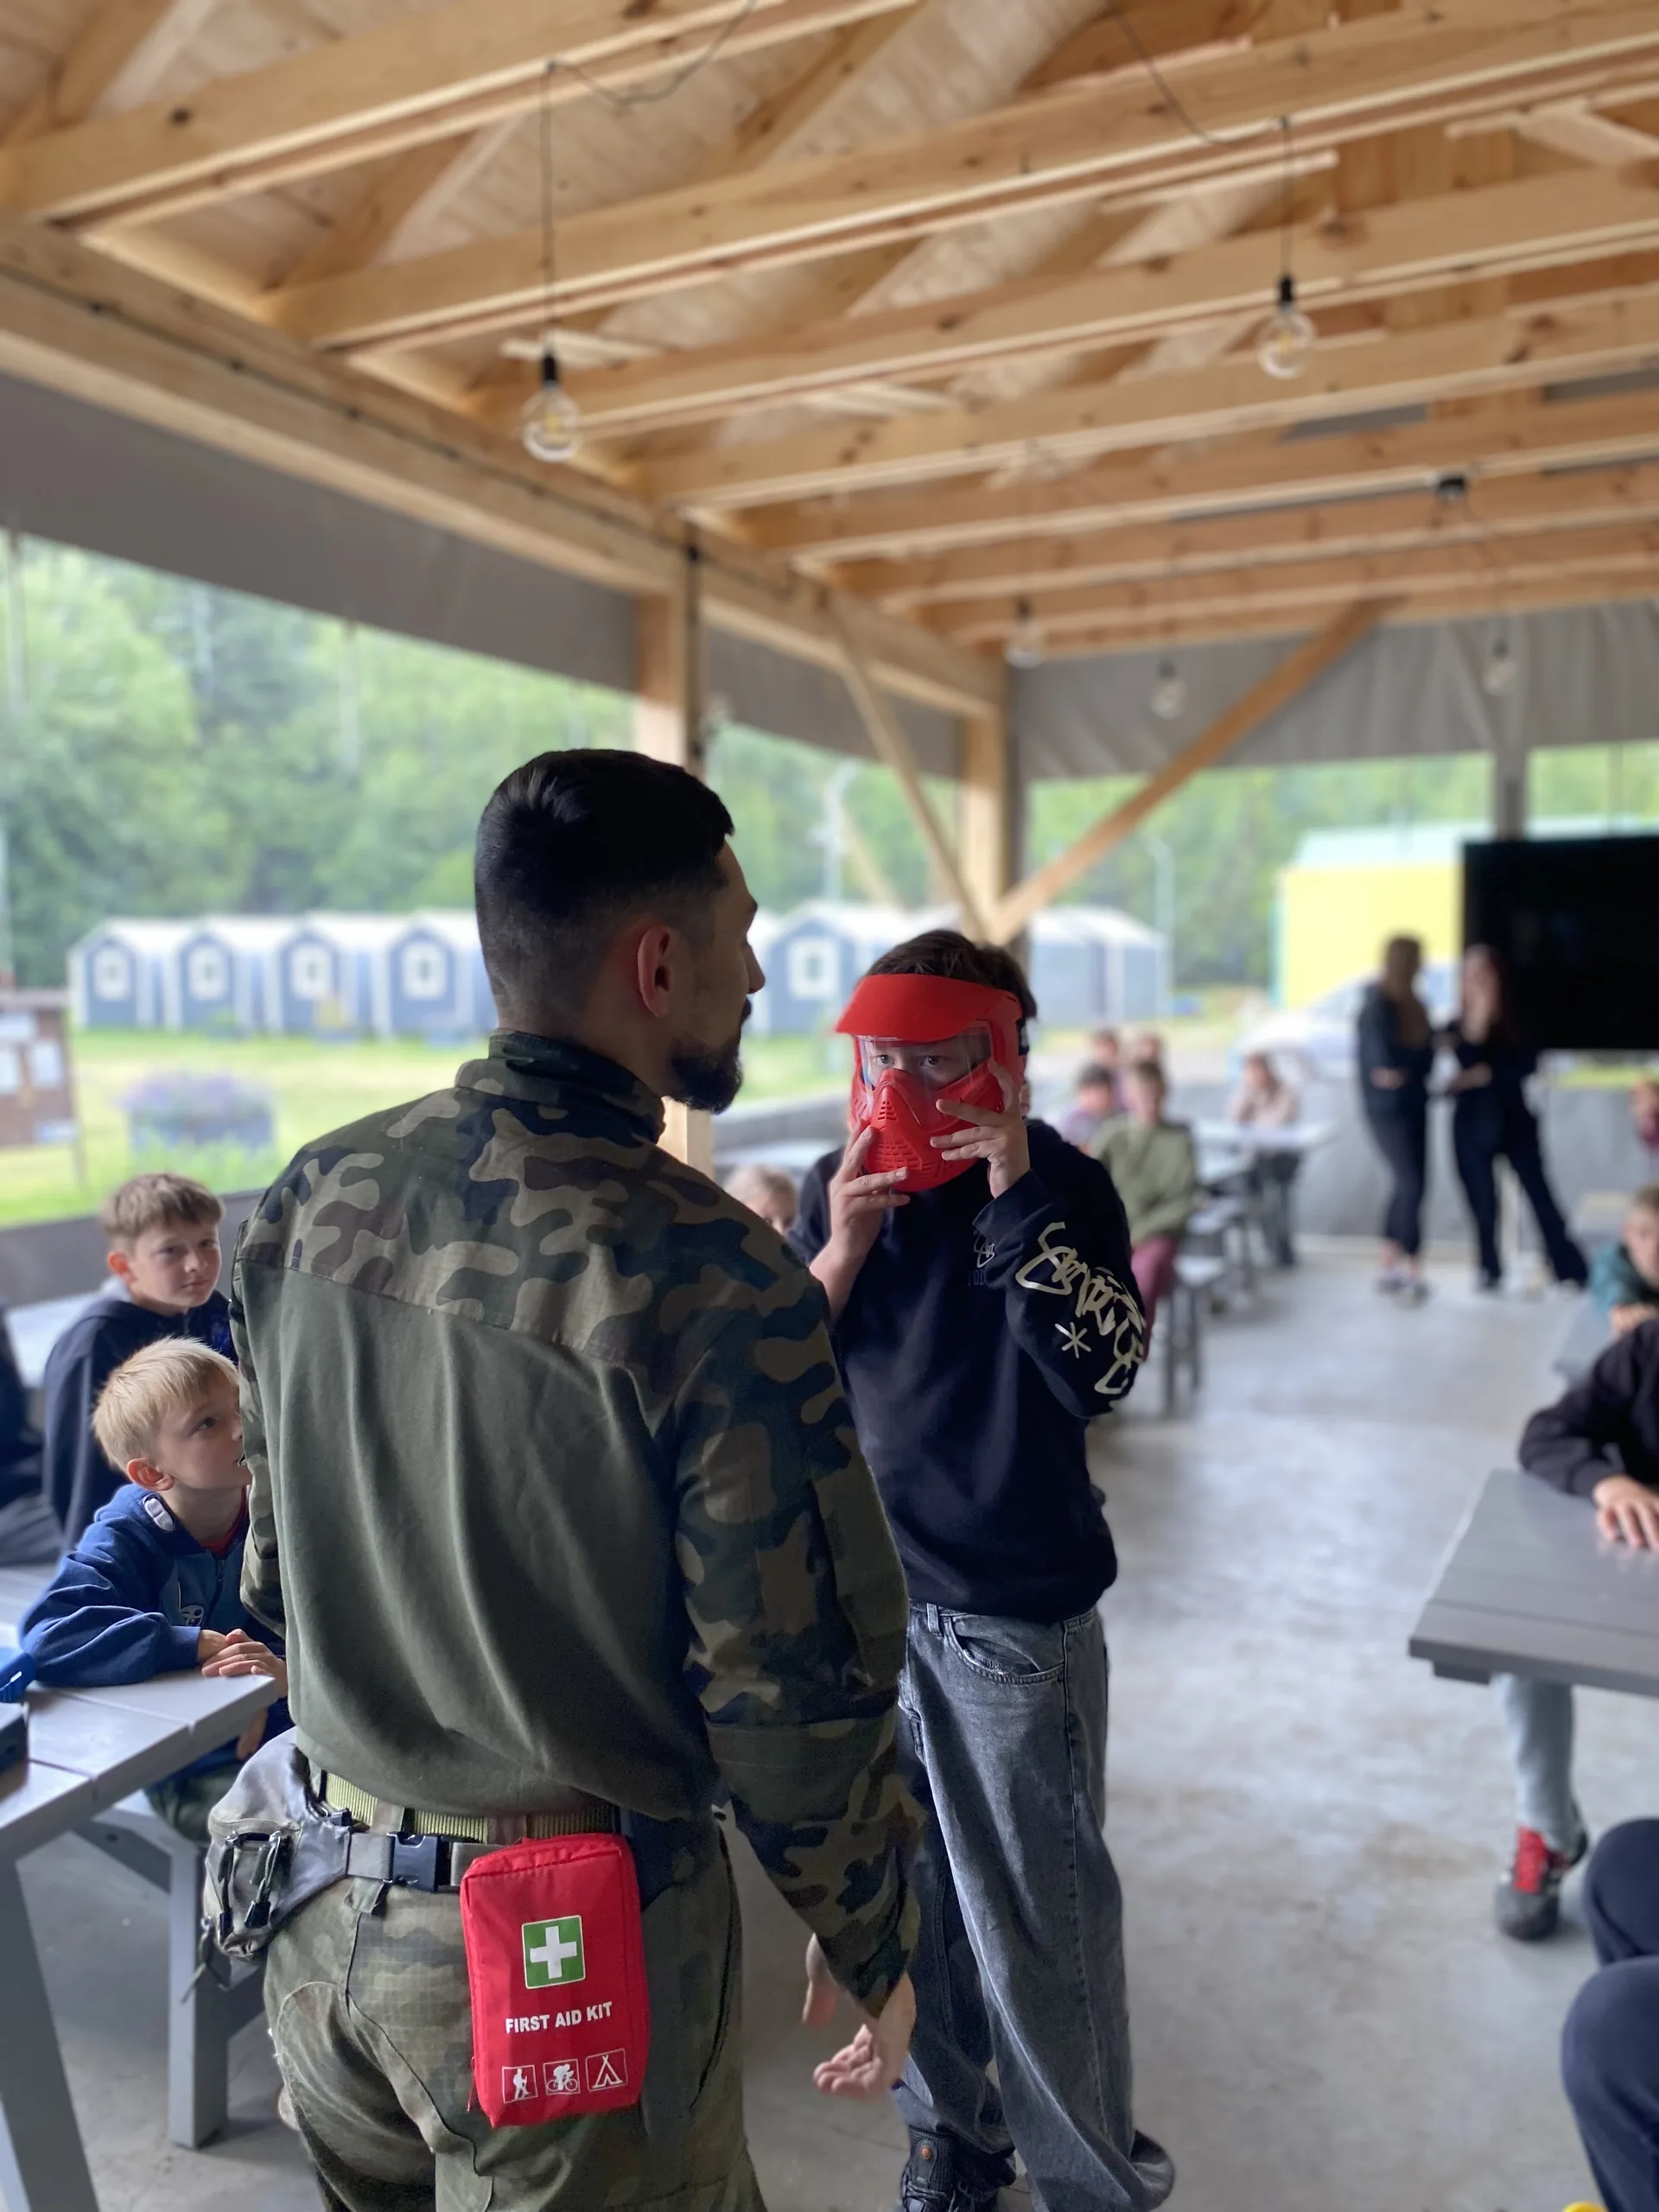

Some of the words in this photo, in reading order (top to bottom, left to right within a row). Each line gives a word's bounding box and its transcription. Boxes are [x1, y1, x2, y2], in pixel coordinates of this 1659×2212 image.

[505, 2014, 550, 2034] FIRST
[555, 2009, 582, 2028] AID
[586, 2001, 613, 2022] KIT
